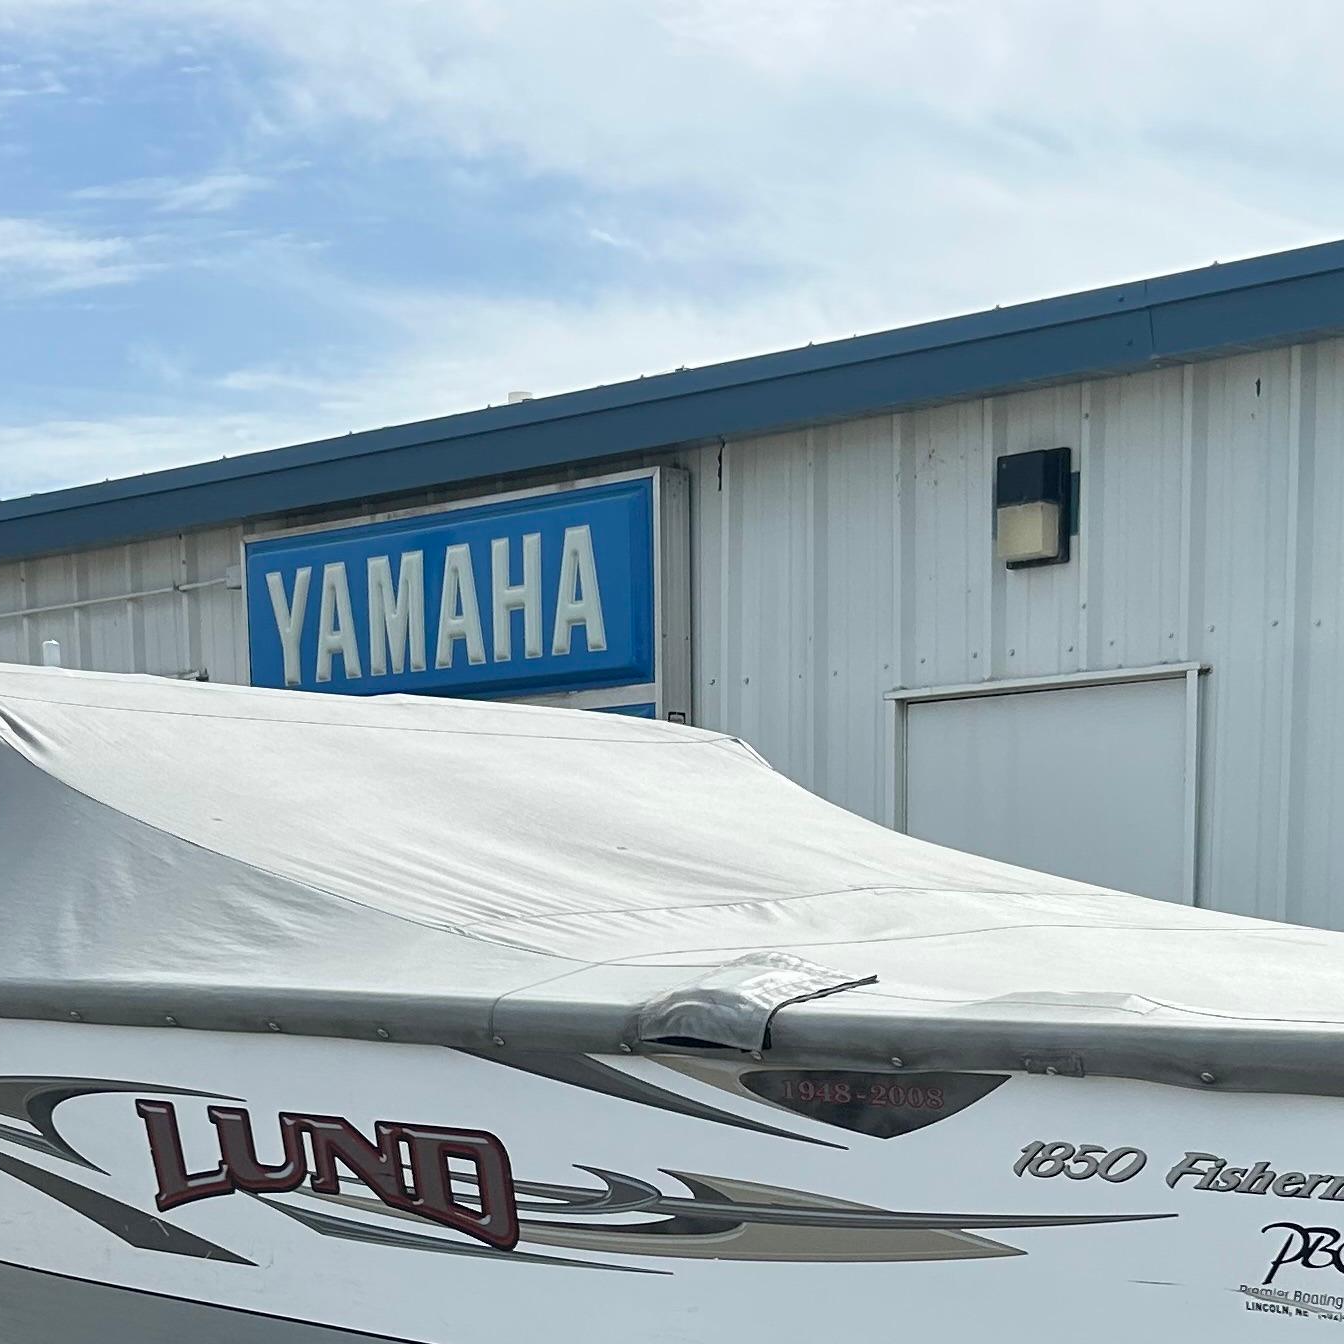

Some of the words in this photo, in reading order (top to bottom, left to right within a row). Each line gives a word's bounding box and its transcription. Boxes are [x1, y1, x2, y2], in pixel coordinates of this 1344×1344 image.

[265, 523, 608, 687] YAMAHA
[134, 1098, 520, 1252] LUND
[1013, 1139, 1147, 1183] 1850
[1245, 1301, 1293, 1317] LINCOLN,
[1295, 1307, 1309, 1317] NE
[1293, 1290, 1344, 1309] Boating
